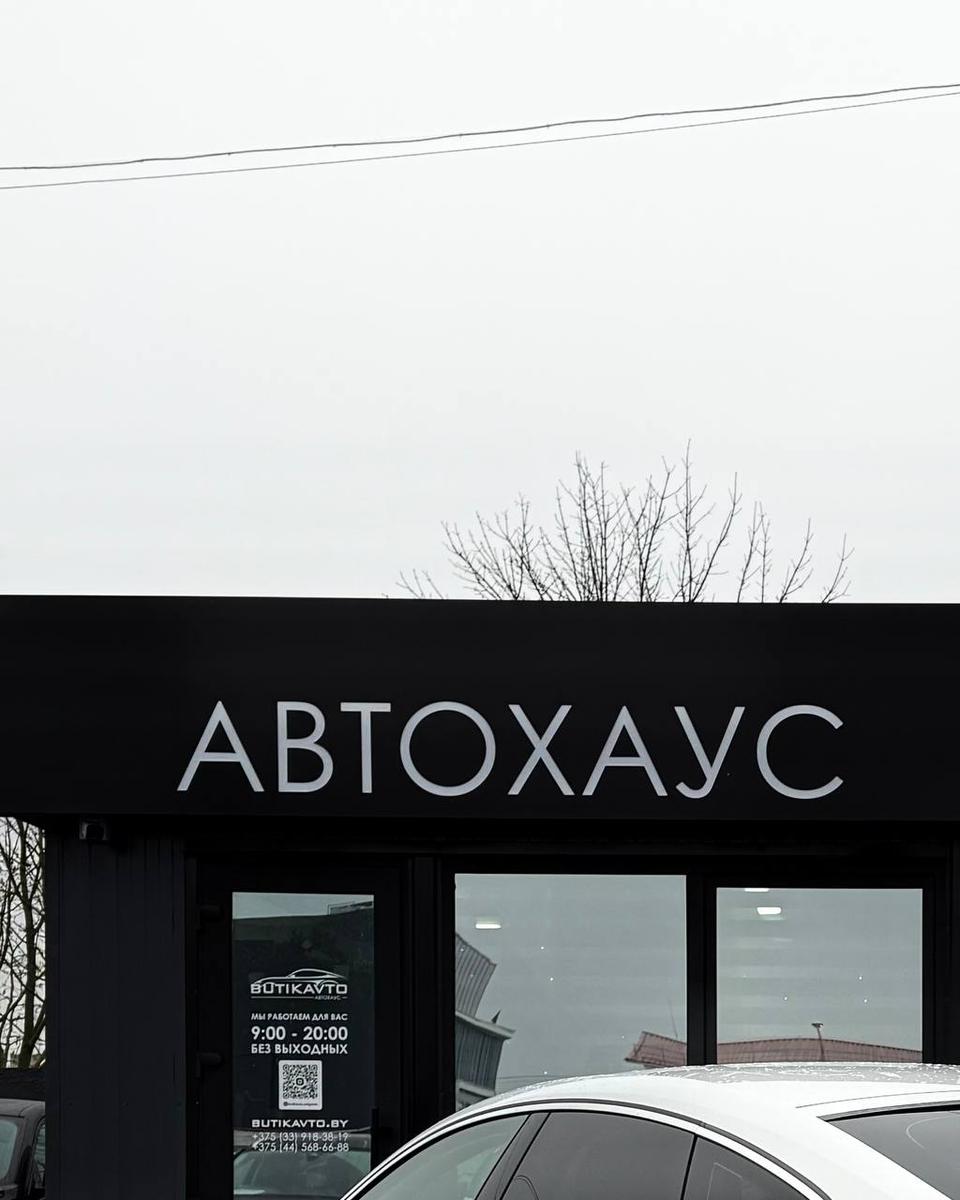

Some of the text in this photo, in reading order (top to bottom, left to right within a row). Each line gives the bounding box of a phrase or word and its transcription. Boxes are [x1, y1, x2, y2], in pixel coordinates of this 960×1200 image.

[177, 699, 845, 801] АВТОХАУС
[250, 983, 348, 995] BUTIKAVTO
[251, 1013, 348, 1022] МЫ РАБОТАЕМ ДЛЯ ВАС
[251, 1026, 286, 1040] 9:00
[303, 1026, 348, 1040] 20:00
[251, 1044, 348, 1055] БЕЗ ВЫХОДНЫХ
[251, 1119, 349, 1128] BUTIKAVTO.BY
[252, 1132, 349, 1142] +375 (33) 918-38-19
[252, 1142, 349, 1153] +375 (44) 568-66-88
